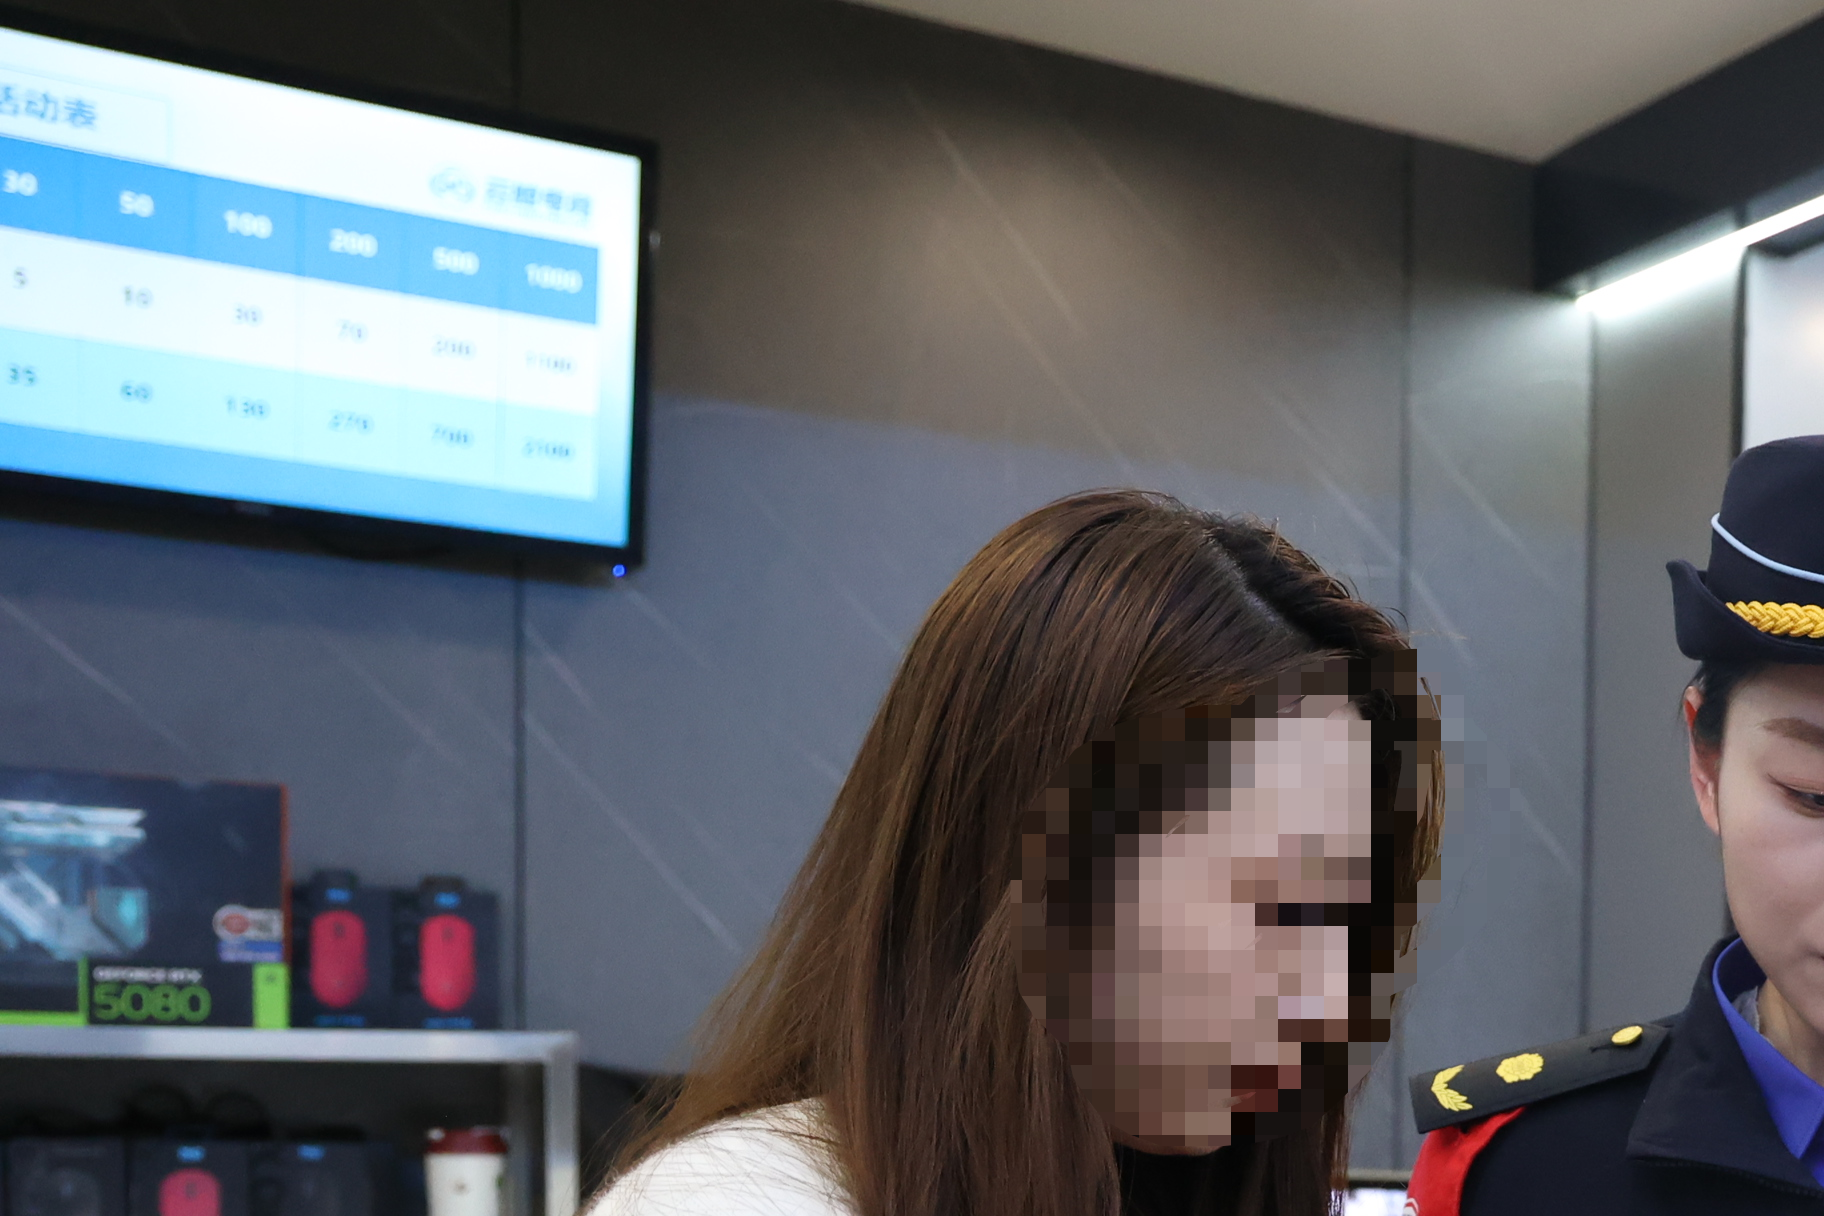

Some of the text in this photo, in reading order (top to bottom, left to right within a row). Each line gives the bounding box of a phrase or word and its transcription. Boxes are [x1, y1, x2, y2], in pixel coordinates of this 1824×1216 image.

[2, 168, 583, 294] 30 50 100 200 500 1000
[13, 267, 28, 289] 5
[122, 285, 153, 310] 10
[6, 363, 38, 388] 35
[119, 379, 153, 404] 60
[93, 982, 212, 1022] 5080
